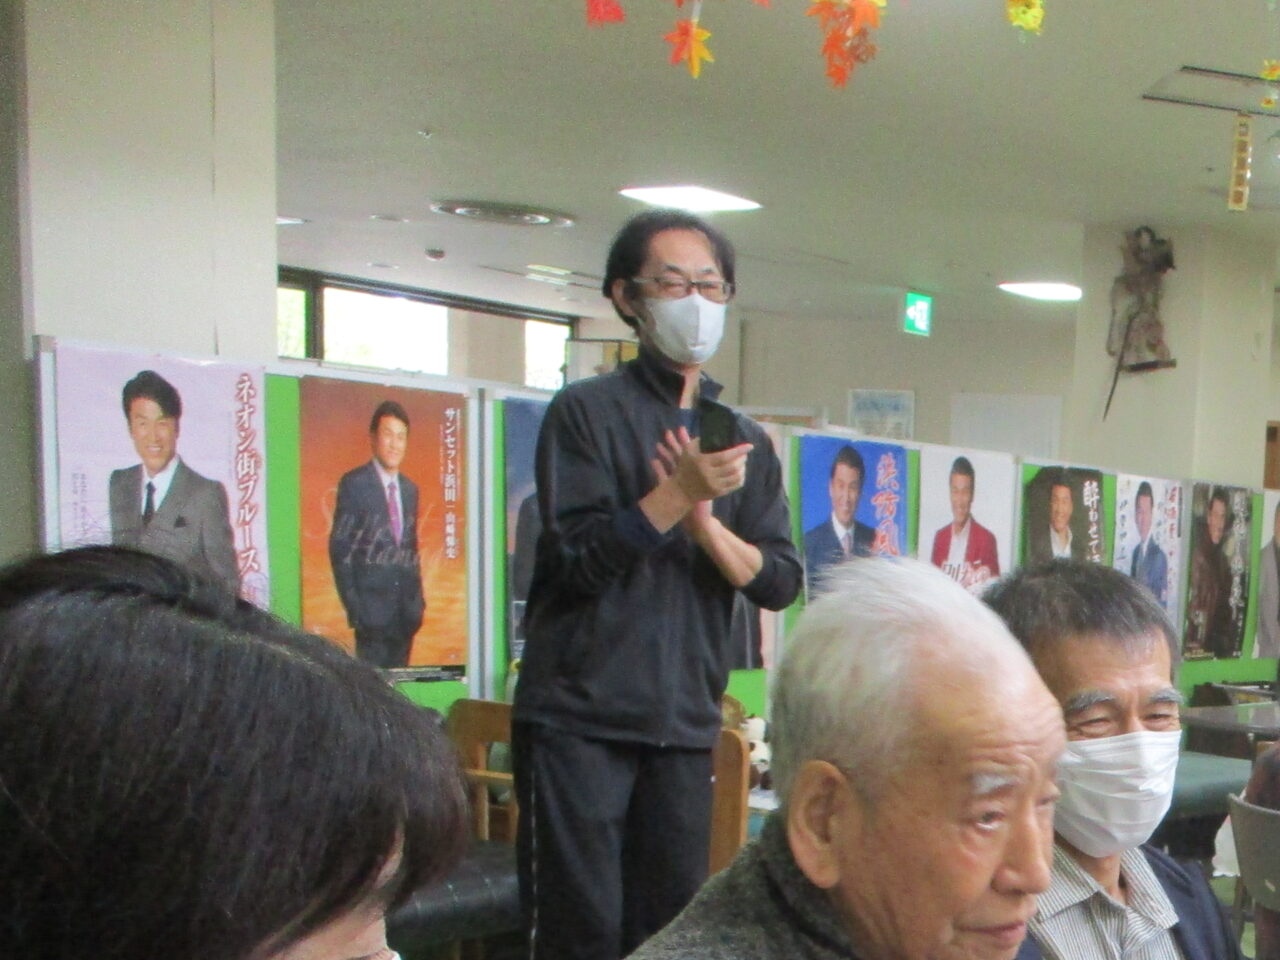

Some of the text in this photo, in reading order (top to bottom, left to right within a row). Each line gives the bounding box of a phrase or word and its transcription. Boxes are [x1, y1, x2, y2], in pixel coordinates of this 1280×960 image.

[235, 374, 260, 576] ネオン街ブルース
